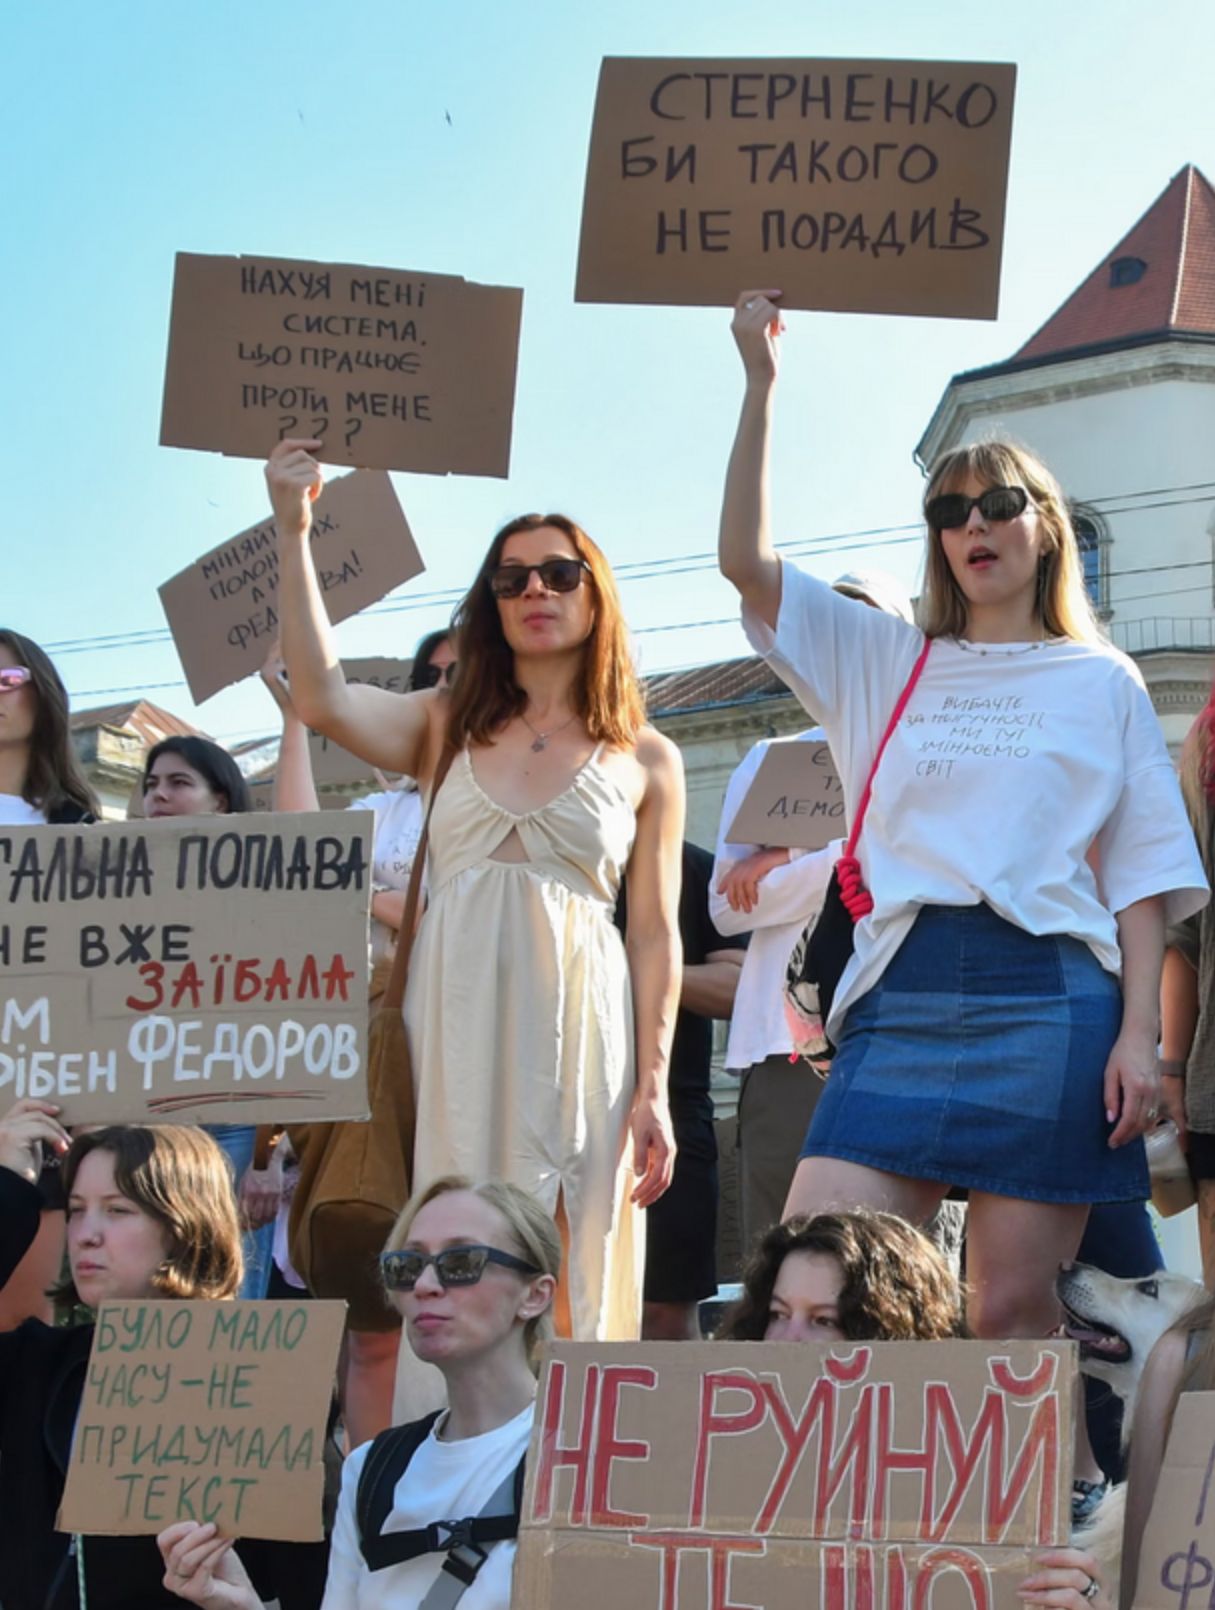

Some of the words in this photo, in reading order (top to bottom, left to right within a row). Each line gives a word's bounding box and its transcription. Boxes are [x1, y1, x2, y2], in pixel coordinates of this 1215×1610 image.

[649, 72, 998, 129] СТЕРНЕНКО
[621, 134, 697, 186] БИ
[737, 139, 939, 185] ТАКОГО
[655, 207, 733, 256] НЕ
[760, 196, 991, 259] ПОРАДИВ
[240, 265, 332, 300] НАХУЯ
[350, 277, 427, 308] МЕНІ
[299, 345, 422, 375] ПРАЦЮЄ
[241, 382, 330, 414] ПРОТИ
[345, 391, 433, 423] МЕНЕ
[176, 831, 368, 892] ПОПЛАВА
[80, 922, 193, 969] ВЖЕ
[125, 953, 356, 1012] ЗАЇБАЛА
[127, 1014, 361, 1091] ФЕДОРОВ
[96, 1307, 193, 1353] БУЛО
[207, 1307, 309, 1351] МАЛО
[88, 1363, 172, 1409] ЧАСУ
[79, 1424, 314, 1472] ПРИДУМАЛА
[531, 1361, 657, 1527] НЕ
[688, 1347, 1060, 1547] РУЙНУЙ
[115, 1473, 259, 1523] ТЕКСТ
